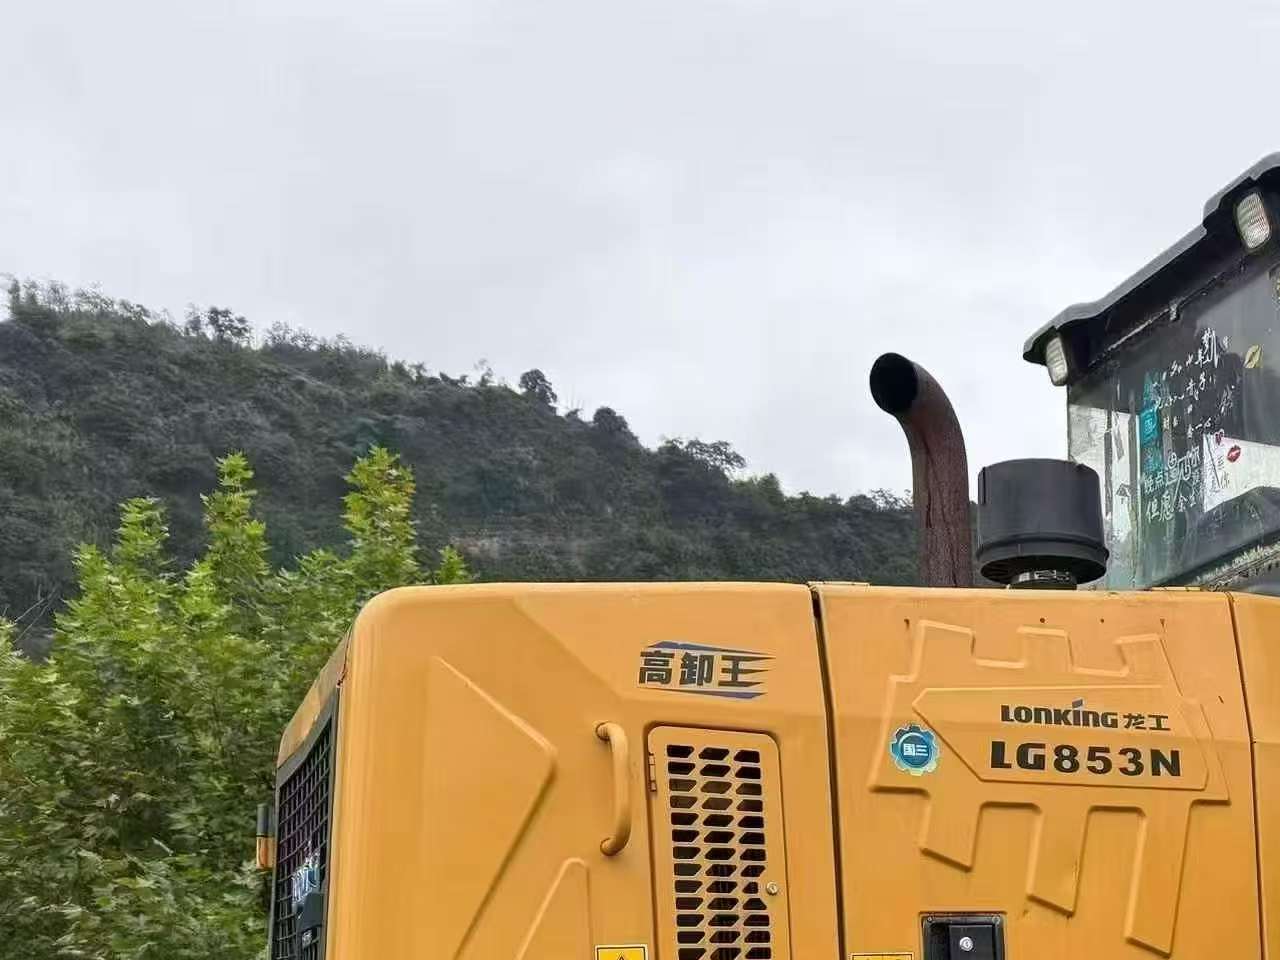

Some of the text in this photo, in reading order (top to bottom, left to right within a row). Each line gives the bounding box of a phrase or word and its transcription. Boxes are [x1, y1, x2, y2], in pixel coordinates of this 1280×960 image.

[638, 650, 776, 687] 高卸王
[1123, 713, 1171, 731] 龙工
[991, 741, 1181, 777] LG853N
